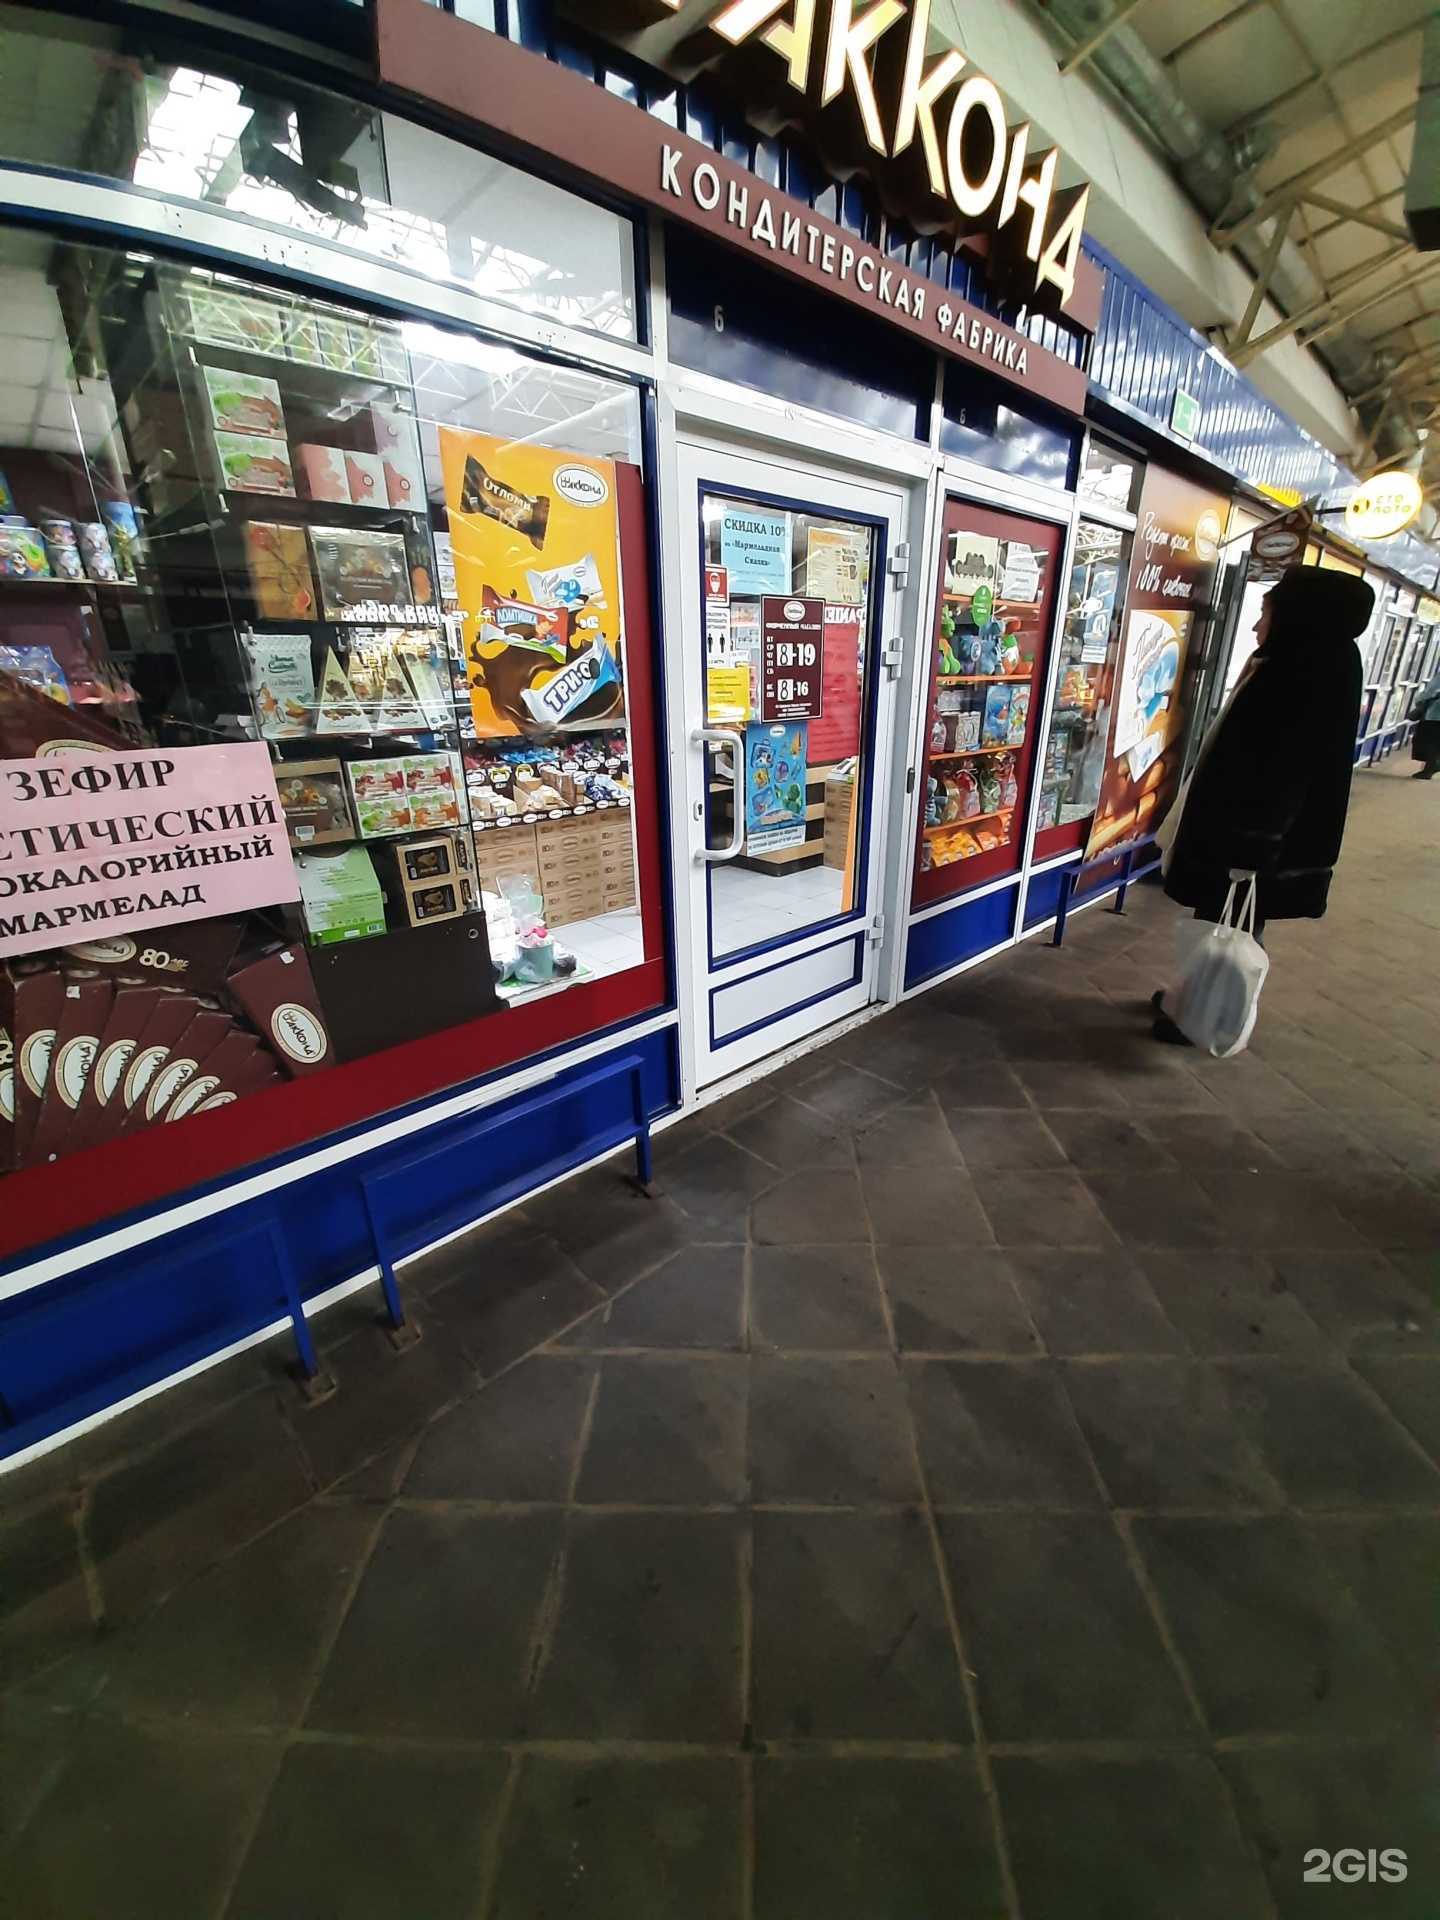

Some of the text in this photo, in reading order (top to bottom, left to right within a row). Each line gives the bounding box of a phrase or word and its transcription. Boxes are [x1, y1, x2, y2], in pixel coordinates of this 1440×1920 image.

[661, 144, 1028, 375] КОНДИТЕРСКАЯ ФАБРИКА
[713, 305, 724, 333] 6
[724, 518, 767, 535] СКИДКА
[7, 759, 175, 801] ЗЕФИР
[0, 884, 206, 937] МАРМЕЛАД
[139, 948, 170, 969] 80
